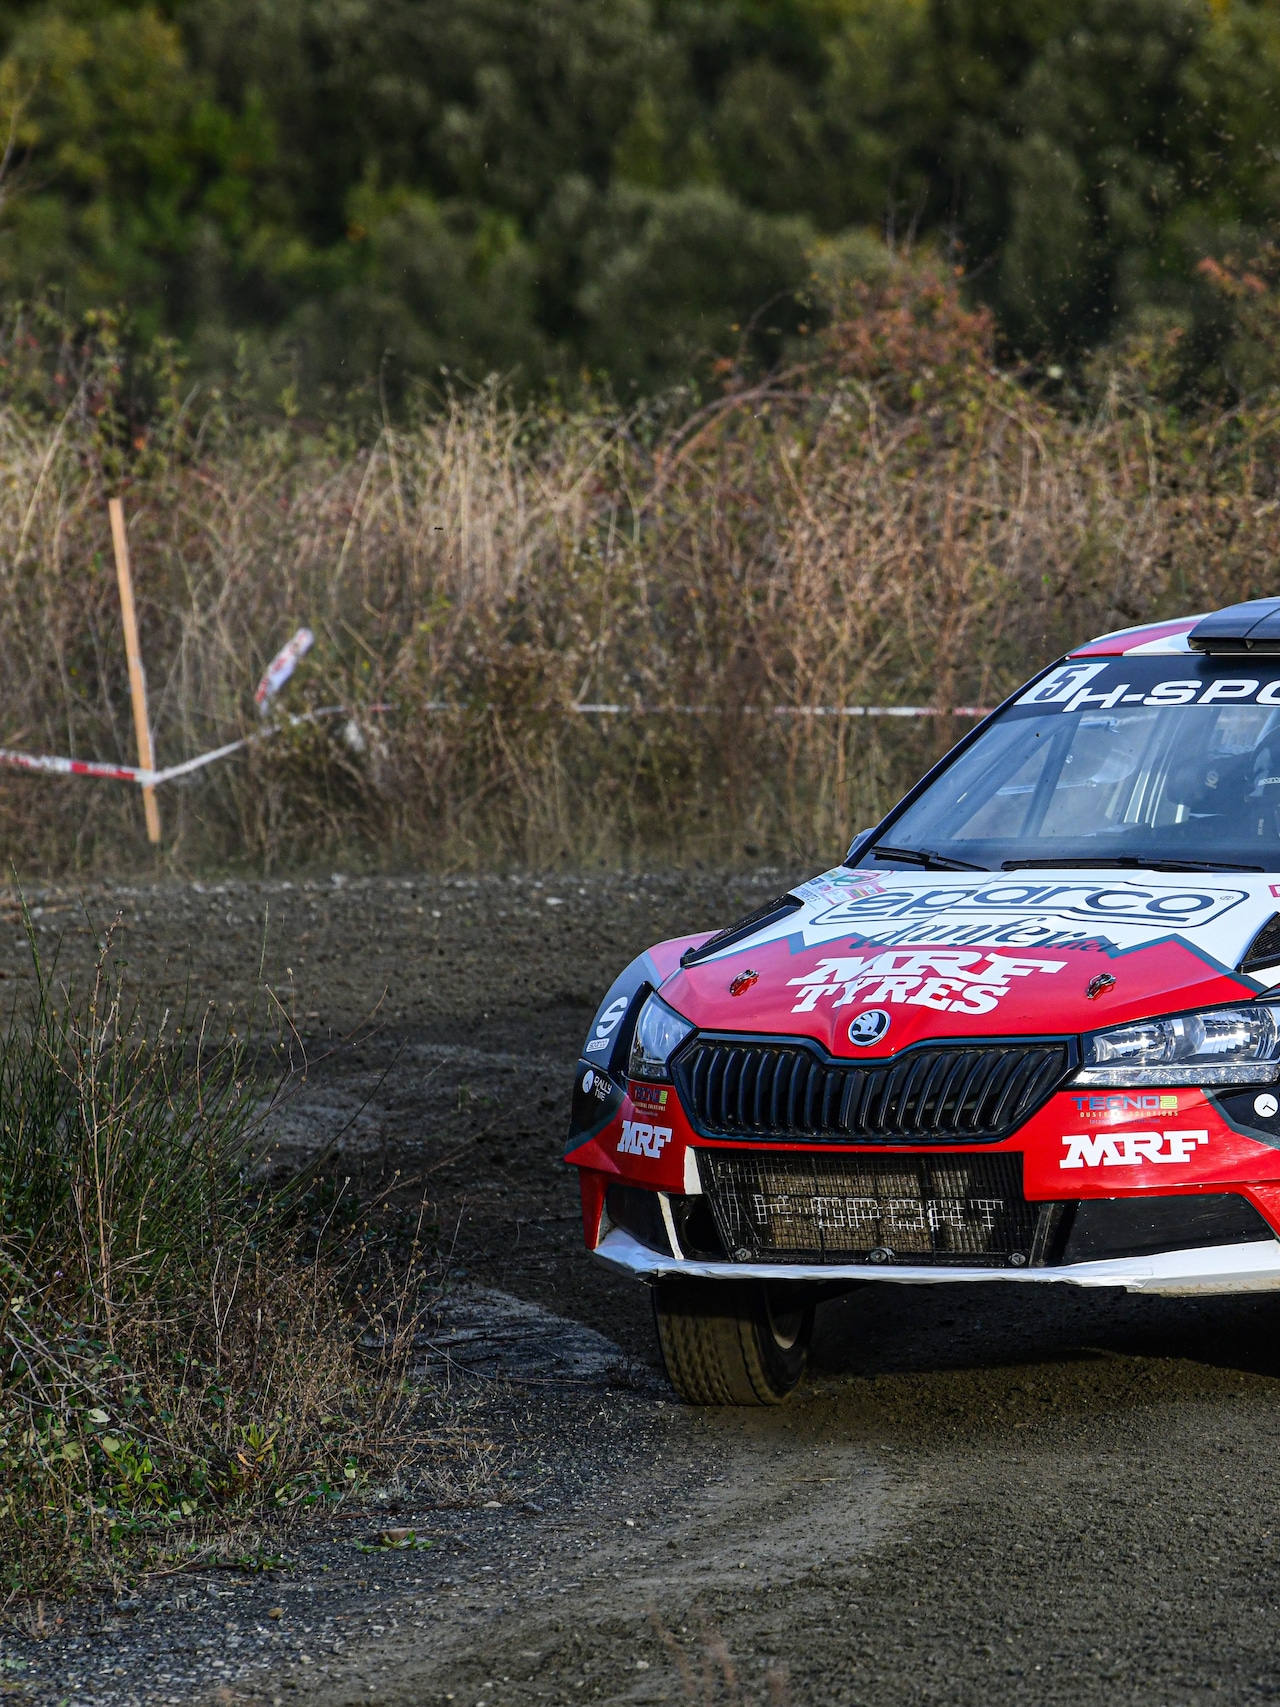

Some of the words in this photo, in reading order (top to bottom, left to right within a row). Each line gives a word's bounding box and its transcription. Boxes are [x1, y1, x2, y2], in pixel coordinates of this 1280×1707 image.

[1034, 666, 1078, 701] 5
[846, 884, 1216, 918] sparco
[786, 950, 1069, 985] MRF
[791, 975, 1010, 1015] TYRES
[594, 1076, 613, 1093] RALLY
[1070, 1095, 1178, 1111] TECNO2
[617, 1120, 673, 1159] MRF
[1059, 1130, 1209, 1169] MRF
